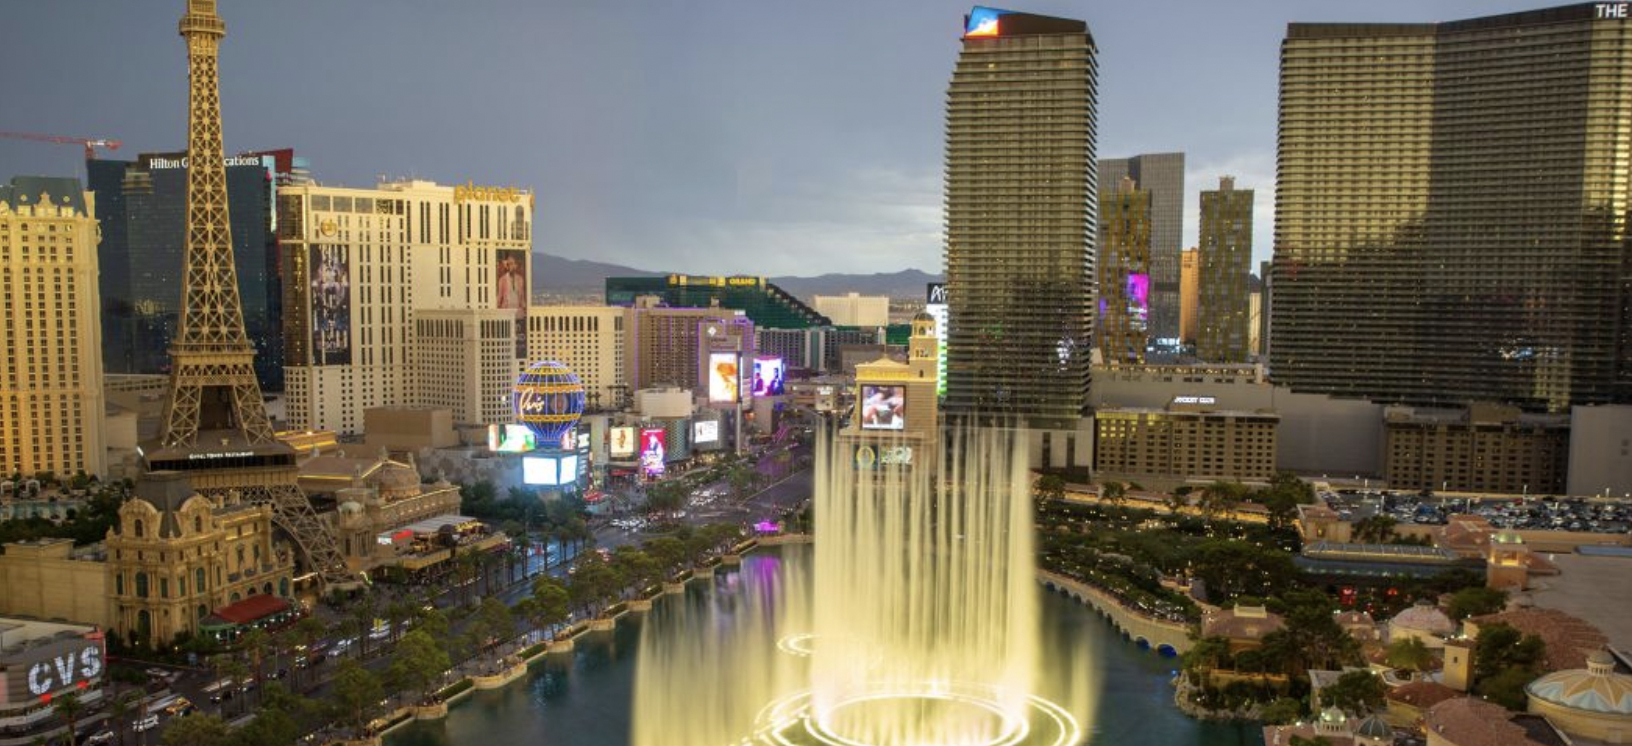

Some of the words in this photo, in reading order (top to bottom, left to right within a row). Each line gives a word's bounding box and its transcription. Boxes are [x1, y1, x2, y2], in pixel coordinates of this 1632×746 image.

[1595, 3, 1628, 18] THE
[150, 157, 180, 169] Hilton
[454, 180, 521, 204] planet
[28, 645, 101, 695] CVS
